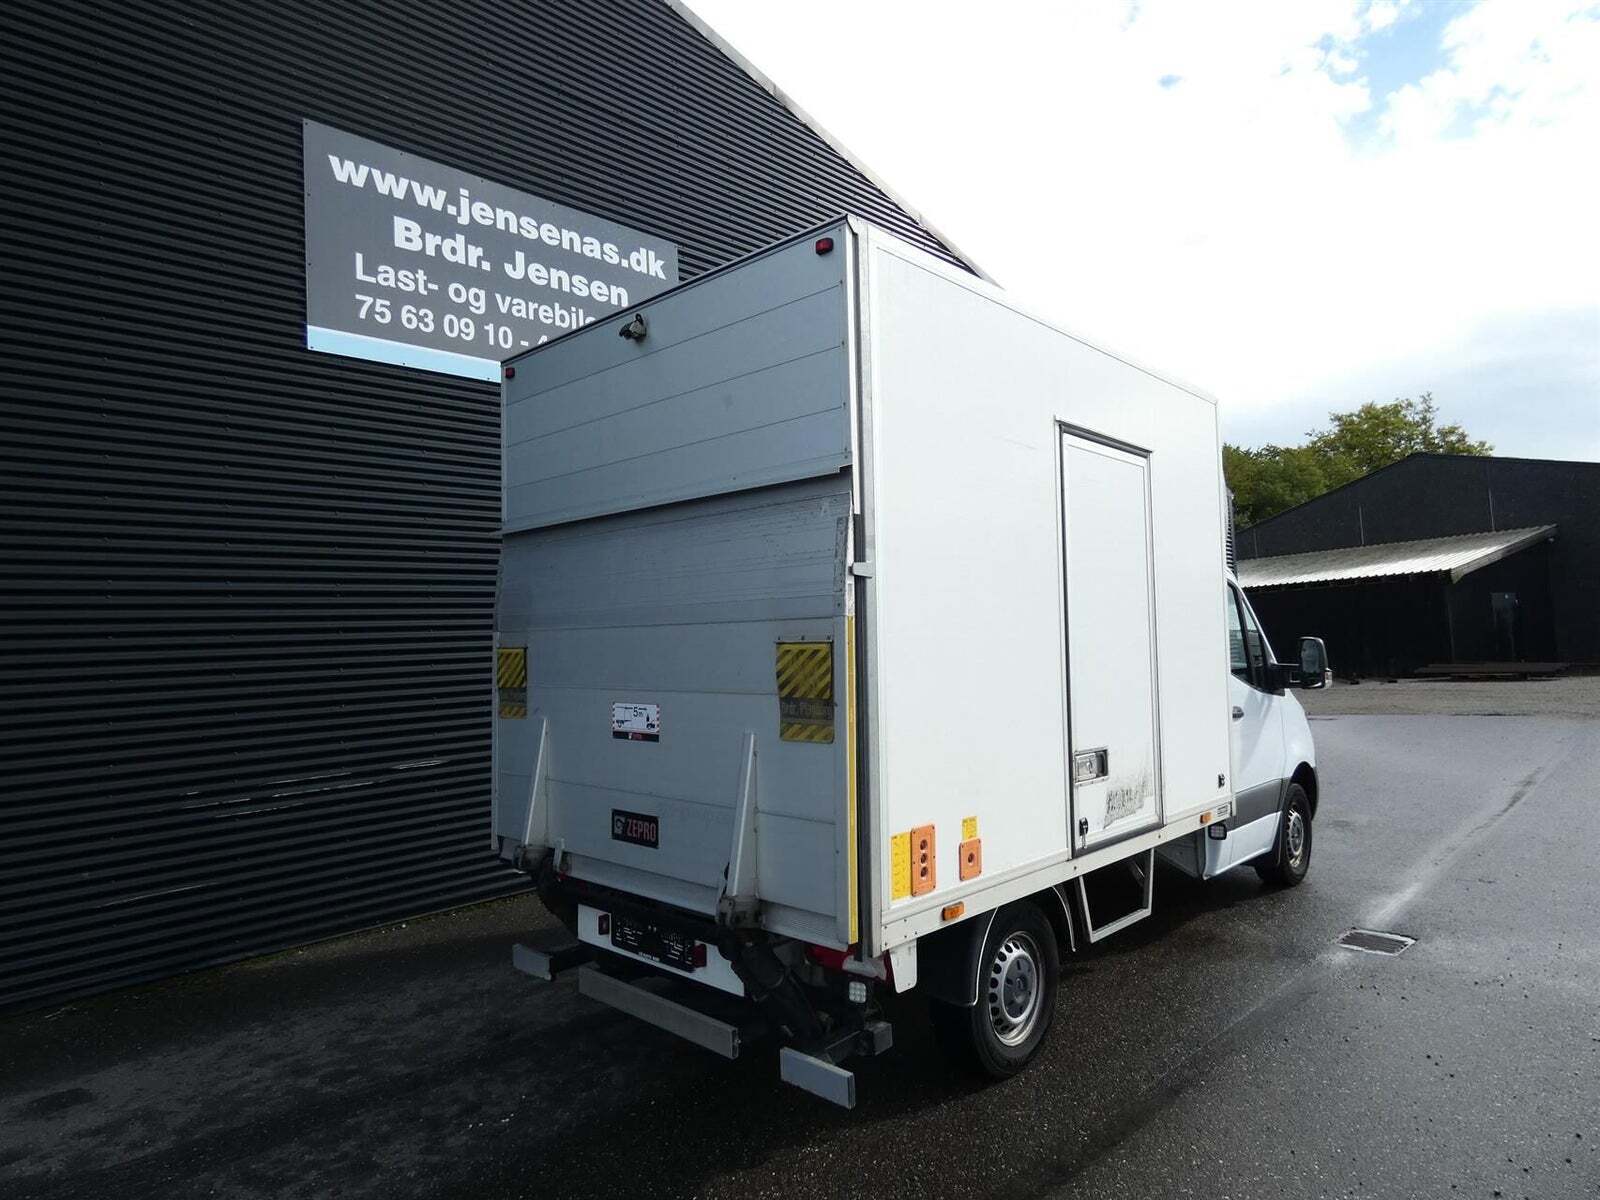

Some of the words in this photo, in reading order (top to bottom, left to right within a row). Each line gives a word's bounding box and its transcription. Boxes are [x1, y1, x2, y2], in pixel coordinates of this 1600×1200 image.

[327, 154, 668, 281] www.jensenas.dk
[355, 251, 439, 296] Last-
[447, 282, 487, 315] og
[393, 215, 491, 272] Brdr.
[503, 250, 630, 309] Jensen
[354, 293, 392, 325] 75
[400, 304, 435, 333] 63
[442, 313, 476, 342] 09
[483, 322, 514, 350] 10
[626, 818, 657, 842] ZEPRO
